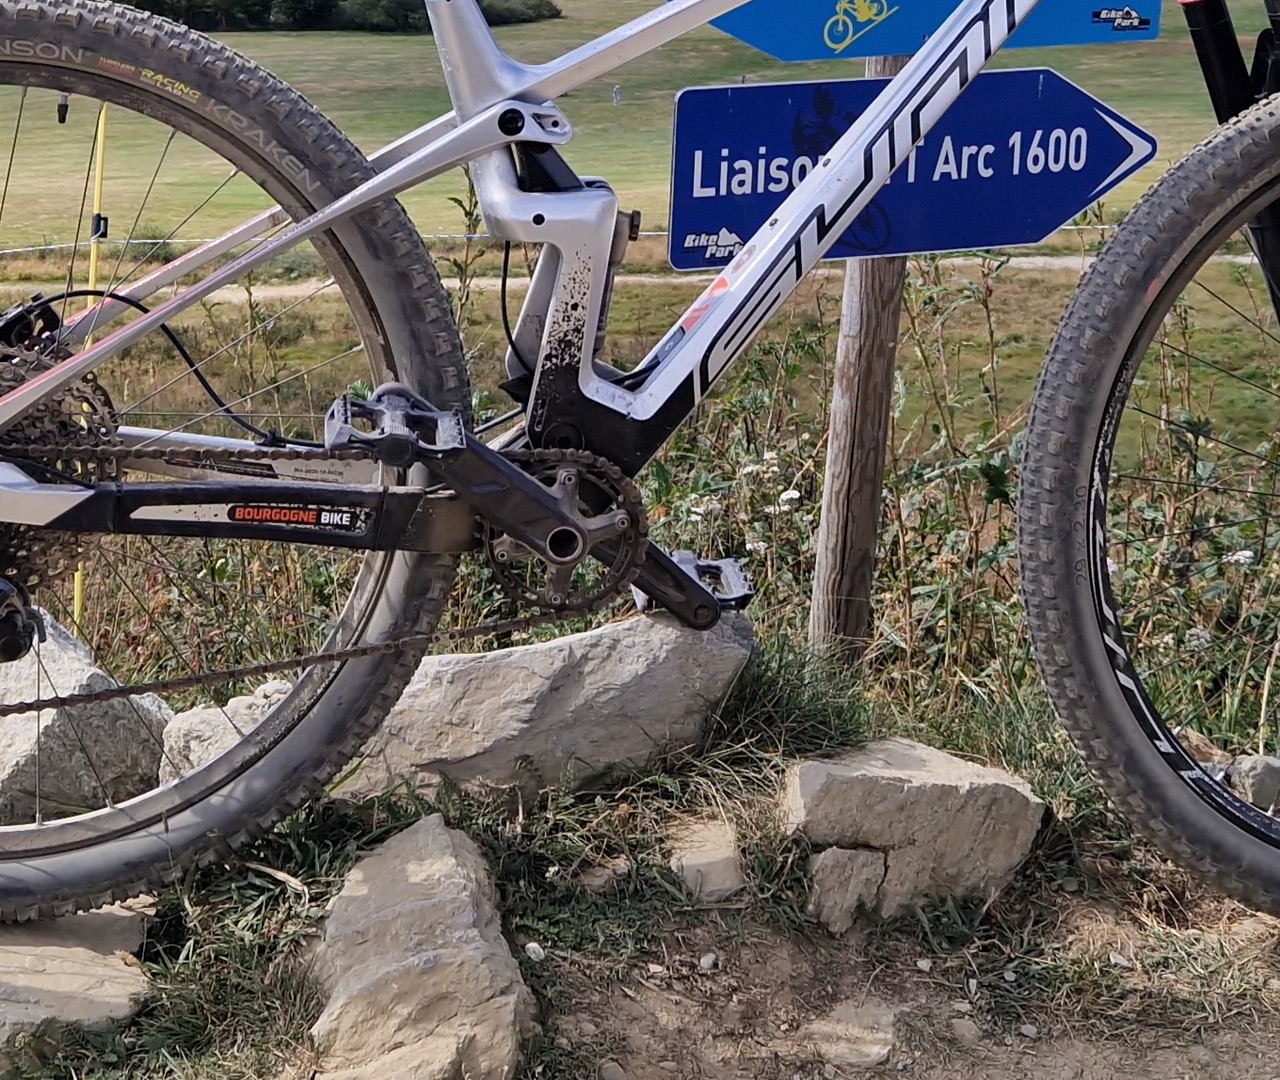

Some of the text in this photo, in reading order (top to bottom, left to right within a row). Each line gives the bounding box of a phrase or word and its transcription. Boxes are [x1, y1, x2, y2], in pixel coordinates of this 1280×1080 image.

[141, 68, 202, 99] RACING
[204, 98, 321, 193] KRAKEN
[692, 146, 824, 198] Liaiso
[932, 135, 994, 182] Arc
[1008, 127, 1088, 176] 1600
[683, 233, 719, 248] Bike
[705, 244, 743, 259] Park
[234, 507, 351, 526] BOURGOGNE BIKE
